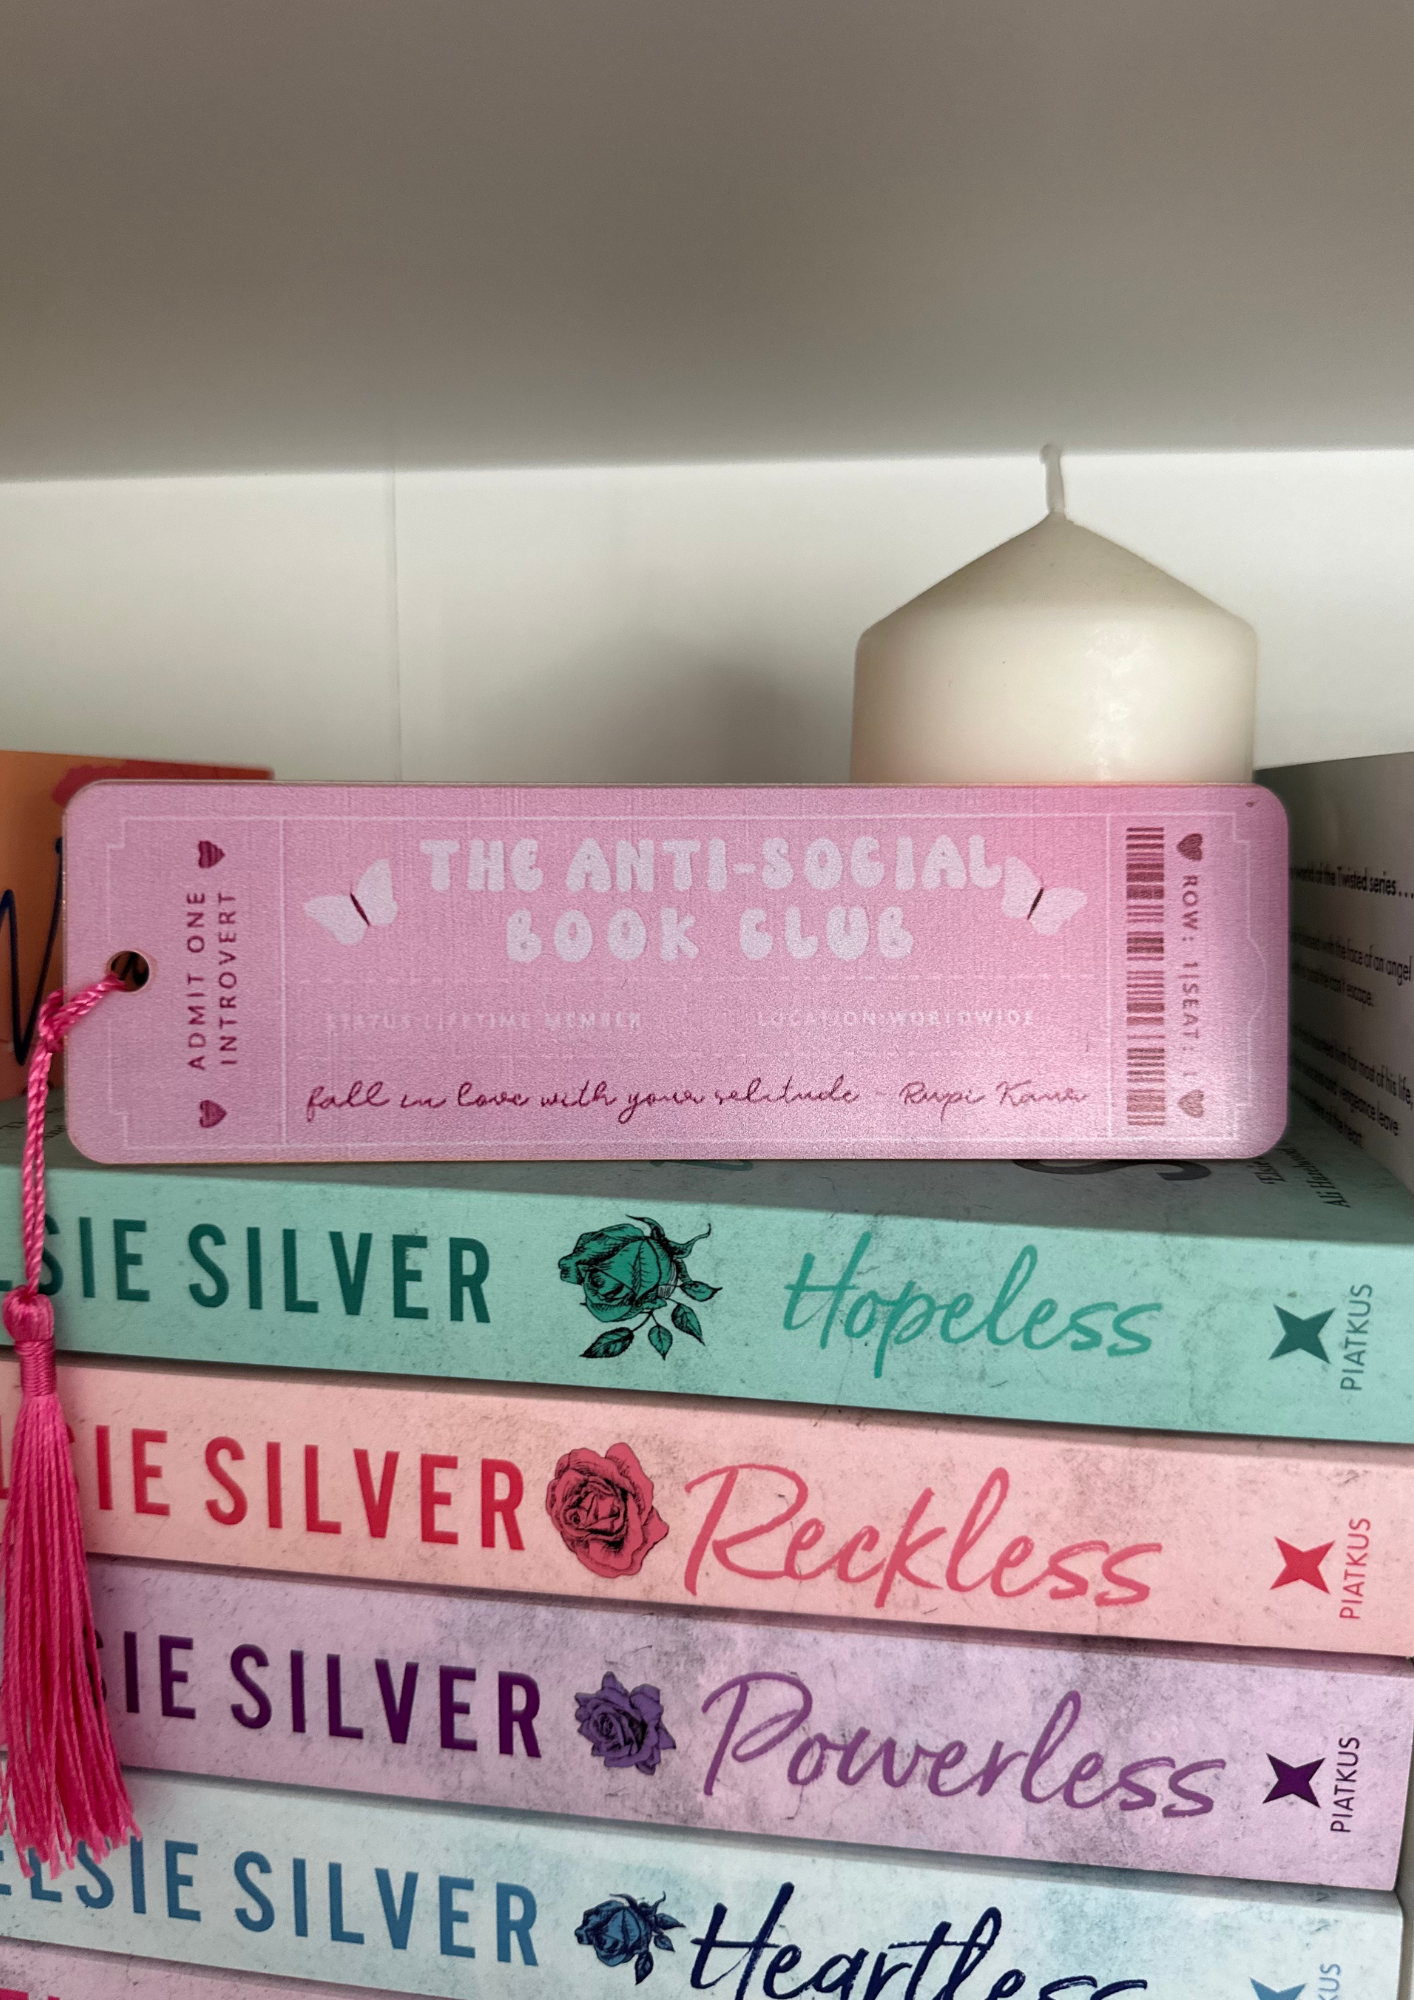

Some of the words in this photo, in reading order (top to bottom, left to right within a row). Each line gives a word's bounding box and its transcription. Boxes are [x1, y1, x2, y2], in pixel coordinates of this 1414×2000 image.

[420, 838, 543, 892] THE
[566, 834, 1002, 892] ANTI-SOCIAL
[1182, 874, 1199, 942] ROW:
[1369, 870, 1397, 896] series
[186, 892, 206, 953] ONE
[506, 907, 699, 963] BOOK
[739, 906, 914, 962] CLUB
[1386, 955, 1412, 987] angel
[187, 972, 207, 1071] ADMIT
[218, 891, 239, 1065] INTROVERT
[306, 1080, 390, 1123] fall
[401, 1093, 447, 1109] in
[457, 1081, 530, 1108] love
[540, 1080, 617, 1108] with
[618, 1089, 705, 1125] your
[713, 1074, 860, 1106] solitude
[899, 1080, 987, 1124] Rupi
[187, 1222, 491, 1325] SILVER
[783, 1231, 1163, 1378] Hopeless
[1340, 1283, 1373, 1391] PIATKUS
[205, 1435, 526, 1551] SILVER
[684, 1463, 1163, 1609] Reckless
[1339, 1516, 1372, 1619] PIATKUS
[230, 1643, 542, 1759] SILVER
[700, 1671, 1227, 1820] Powerless
[1330, 1735, 1361, 1833] PIATKUS
[233, 1850, 540, 1968] SILVER
